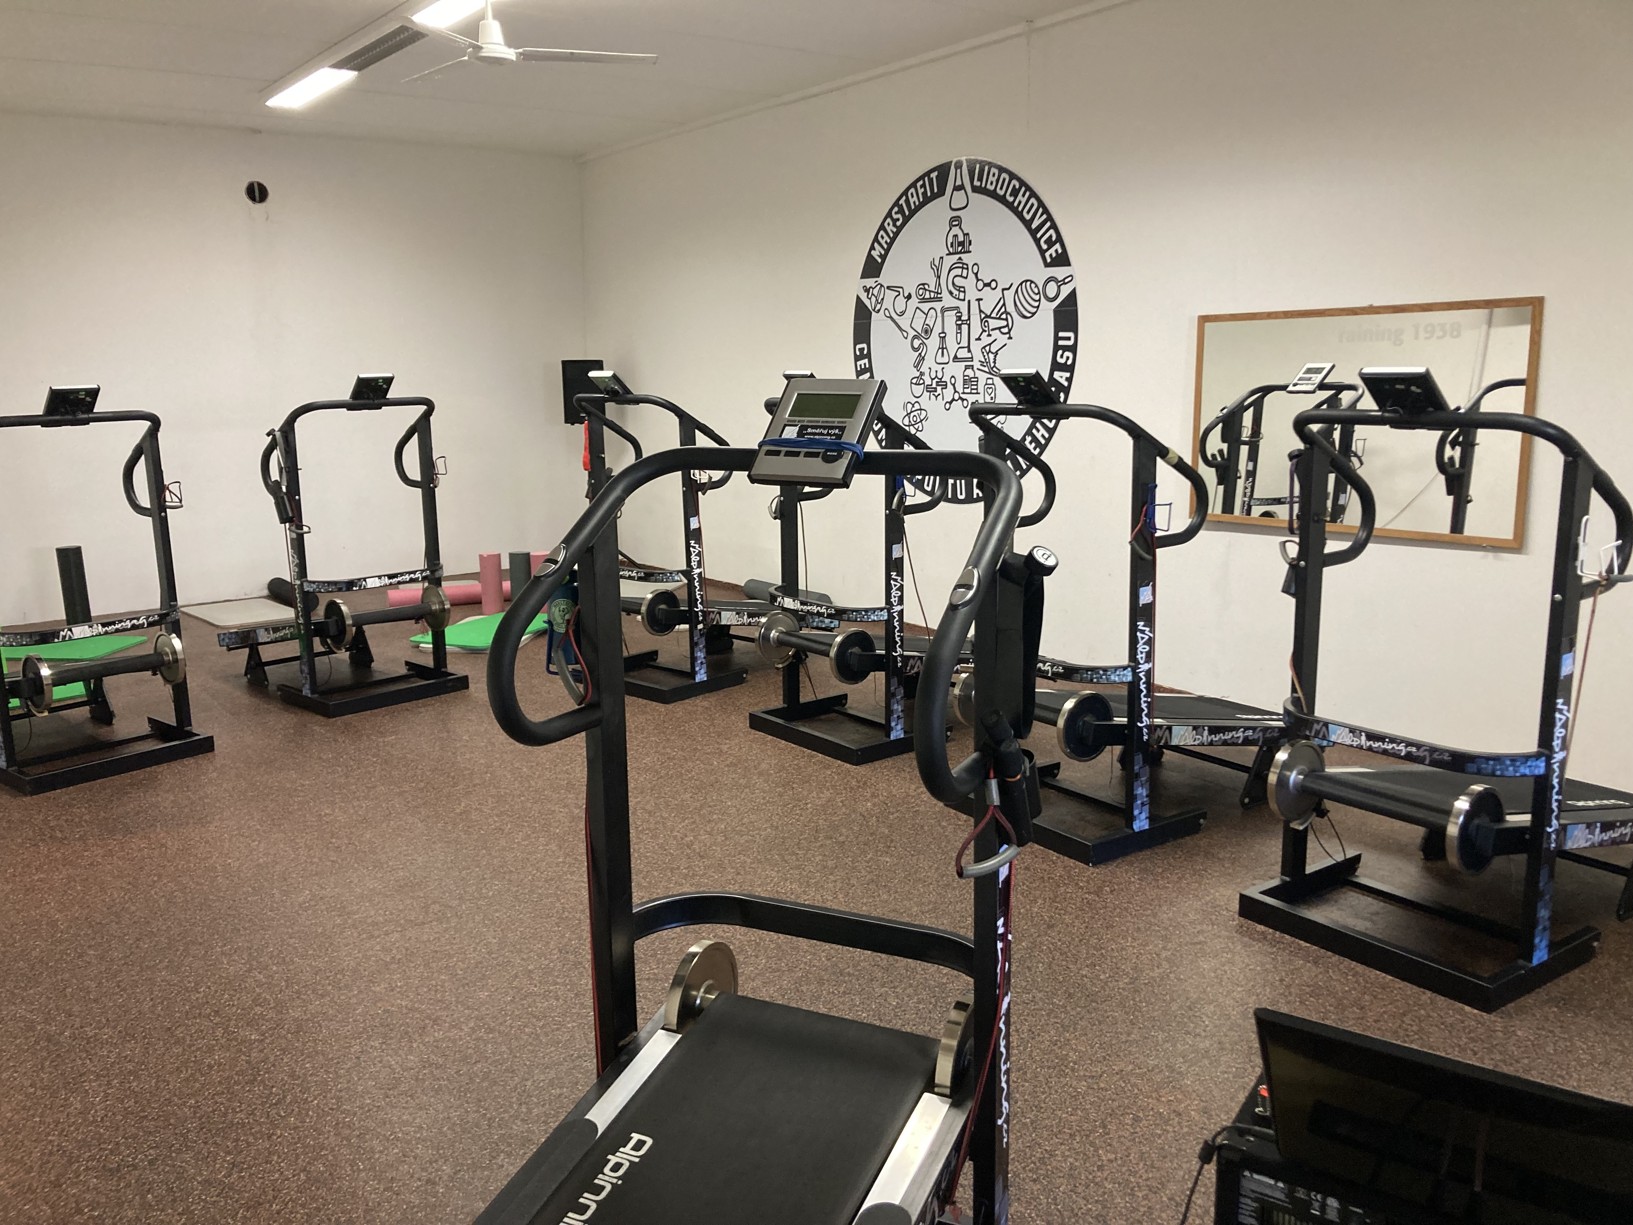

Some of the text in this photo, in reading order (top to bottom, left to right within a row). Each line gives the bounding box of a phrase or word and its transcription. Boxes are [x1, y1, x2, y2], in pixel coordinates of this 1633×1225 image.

[871, 164, 1062, 263] MARSTAFIT LIBOCHOVICE
[1411, 321, 1462, 341] 1938
